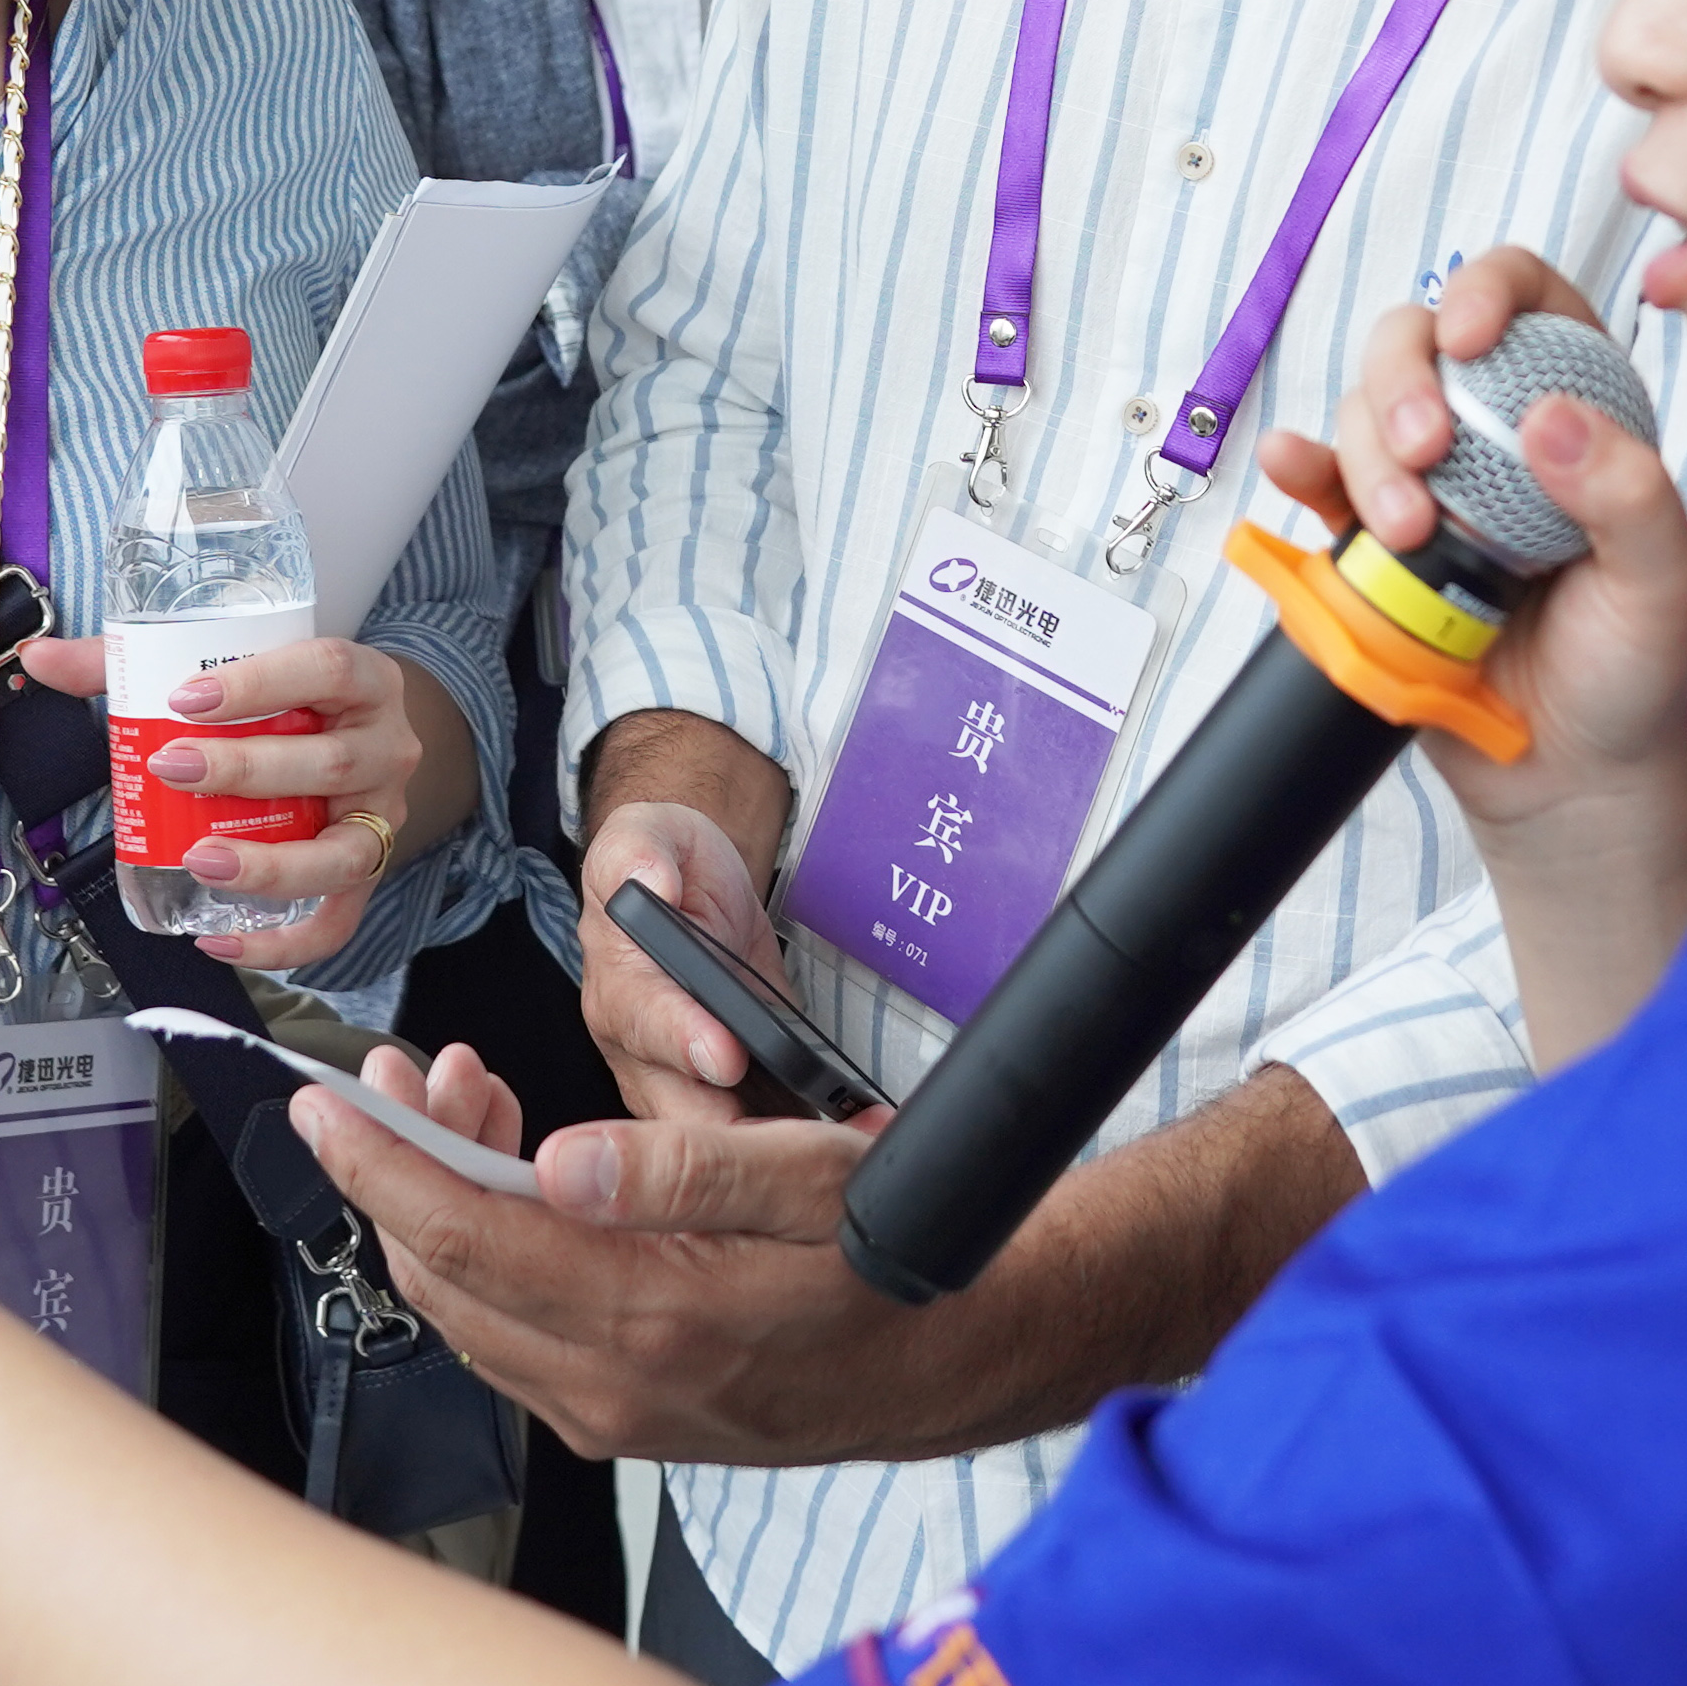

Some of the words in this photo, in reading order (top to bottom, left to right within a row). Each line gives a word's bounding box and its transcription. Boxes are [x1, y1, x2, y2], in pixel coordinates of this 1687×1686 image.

[973, 576, 1061, 640] 捷迅光电
[890, 862, 954, 927] VIP
[17, 1054, 94, 1085] 捷迅光电
